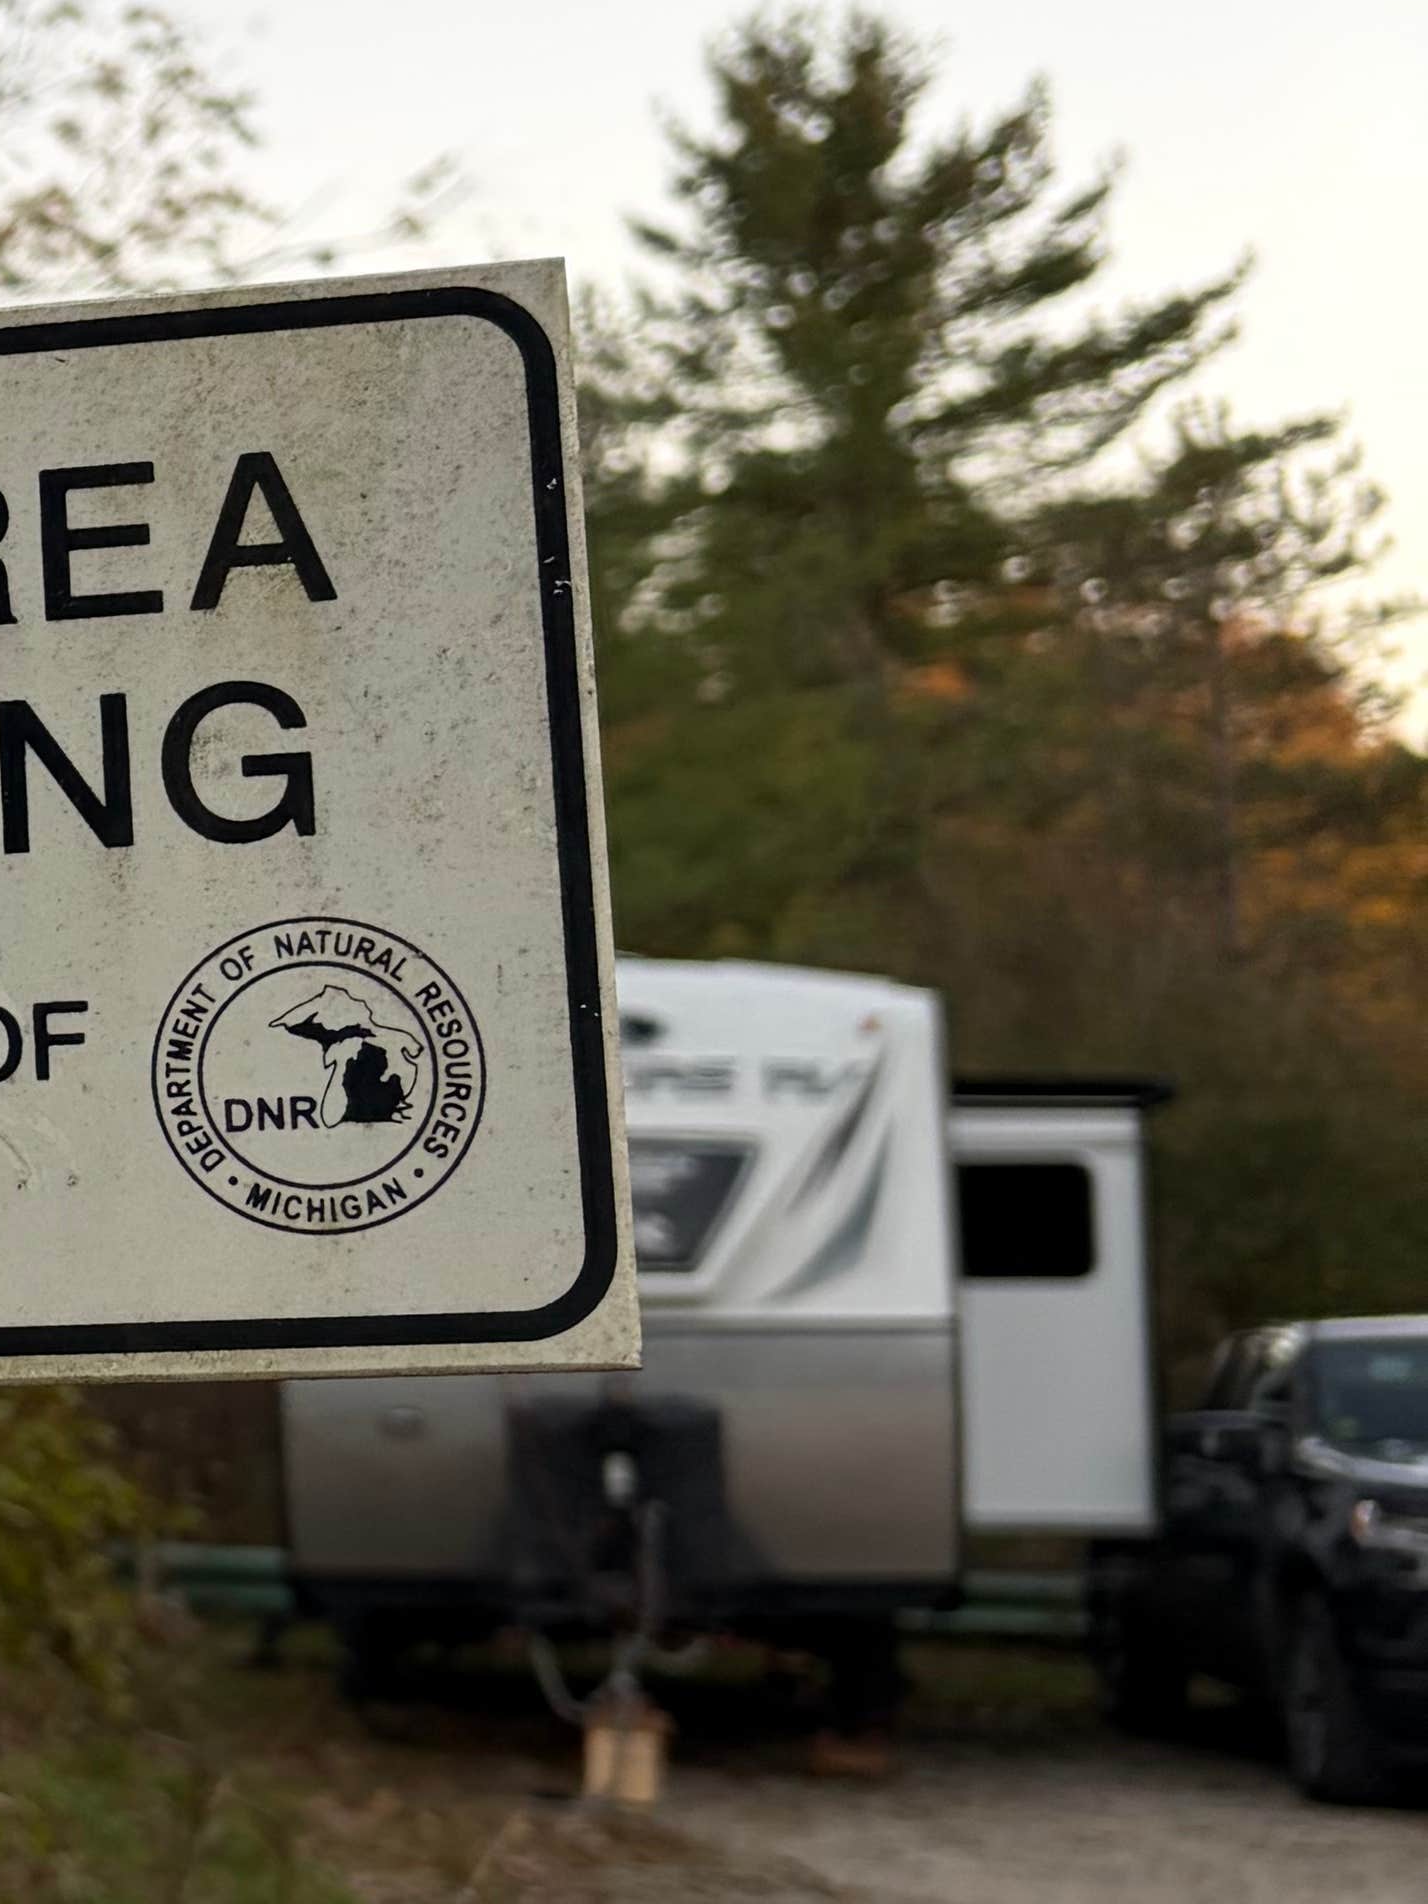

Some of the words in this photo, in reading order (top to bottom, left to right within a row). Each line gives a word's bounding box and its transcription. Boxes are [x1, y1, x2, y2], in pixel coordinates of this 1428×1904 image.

[165, 983, 227, 1173] DEPARTMENT
[219, 945, 255, 982] OF
[274, 930, 409, 982] NATURAL
[414, 981, 472, 1159] RESOURCES
[224, 1096, 320, 1132] DNR
[245, 1177, 408, 1223] MICHIGAN
